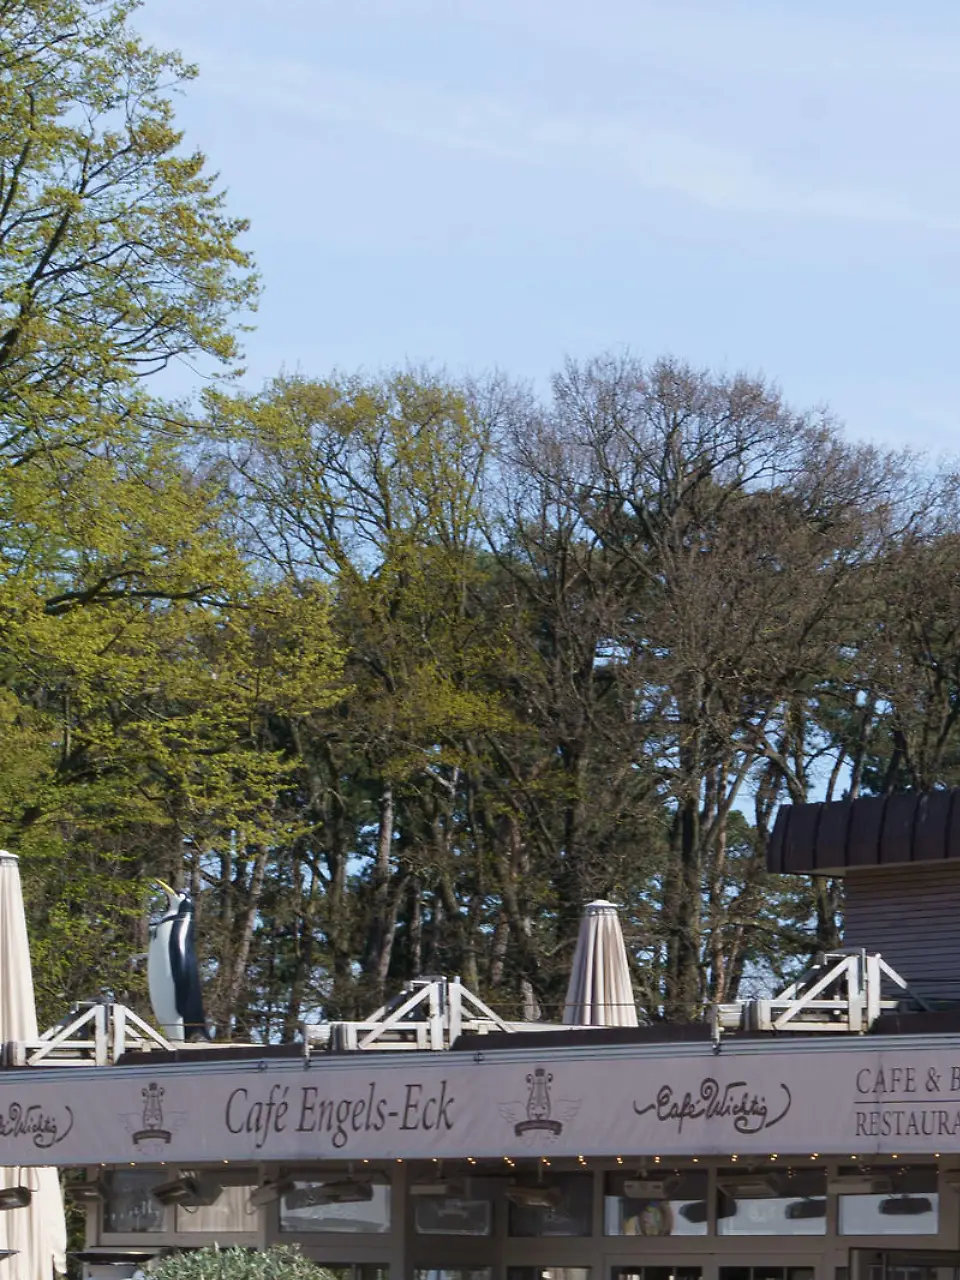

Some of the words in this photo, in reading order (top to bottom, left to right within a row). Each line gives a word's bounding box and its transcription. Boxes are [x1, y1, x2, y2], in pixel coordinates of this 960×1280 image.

[650, 1084, 705, 1134] Café
[701, 1077, 768, 1134] Wichtig
[856, 1067, 917, 1094] CAFE
[925, 1066, 941, 1092] &
[225, 1084, 290, 1148] Café
[295, 1079, 454, 1148] Engels-Eck
